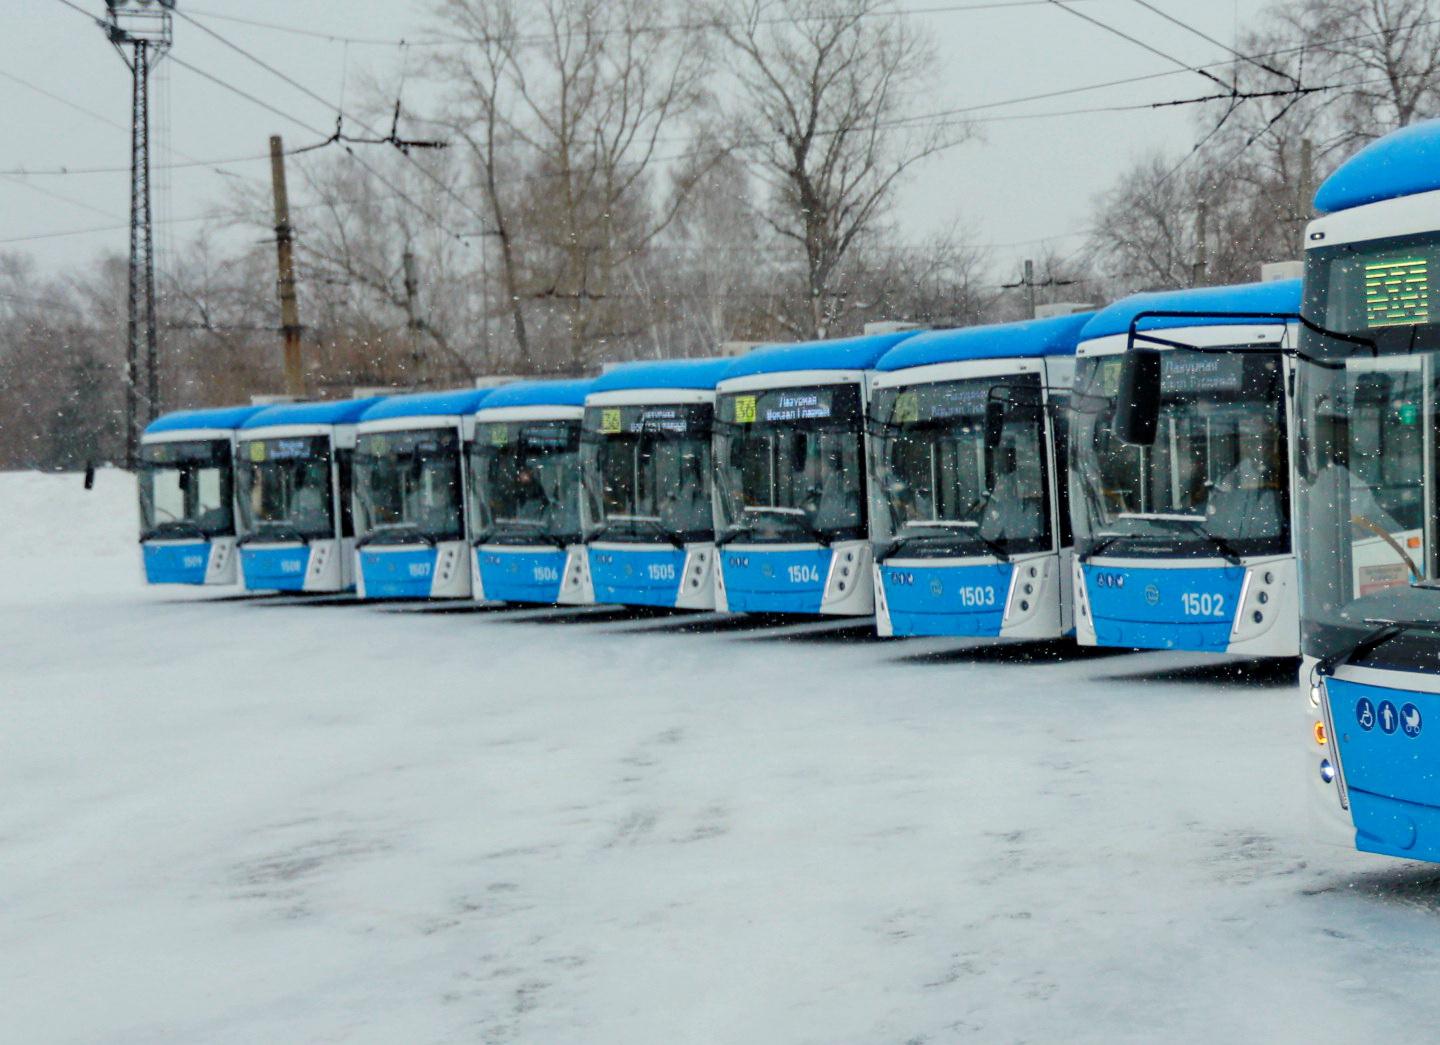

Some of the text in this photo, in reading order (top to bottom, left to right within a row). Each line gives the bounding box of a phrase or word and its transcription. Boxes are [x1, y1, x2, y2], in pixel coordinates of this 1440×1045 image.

[408, 562, 431, 576] 1507
[533, 566, 558, 580] 1506
[648, 564, 675, 579] 1505
[787, 566, 819, 583] 1504
[959, 586, 995, 606] 1503
[1181, 593, 1225, 616] 1502
